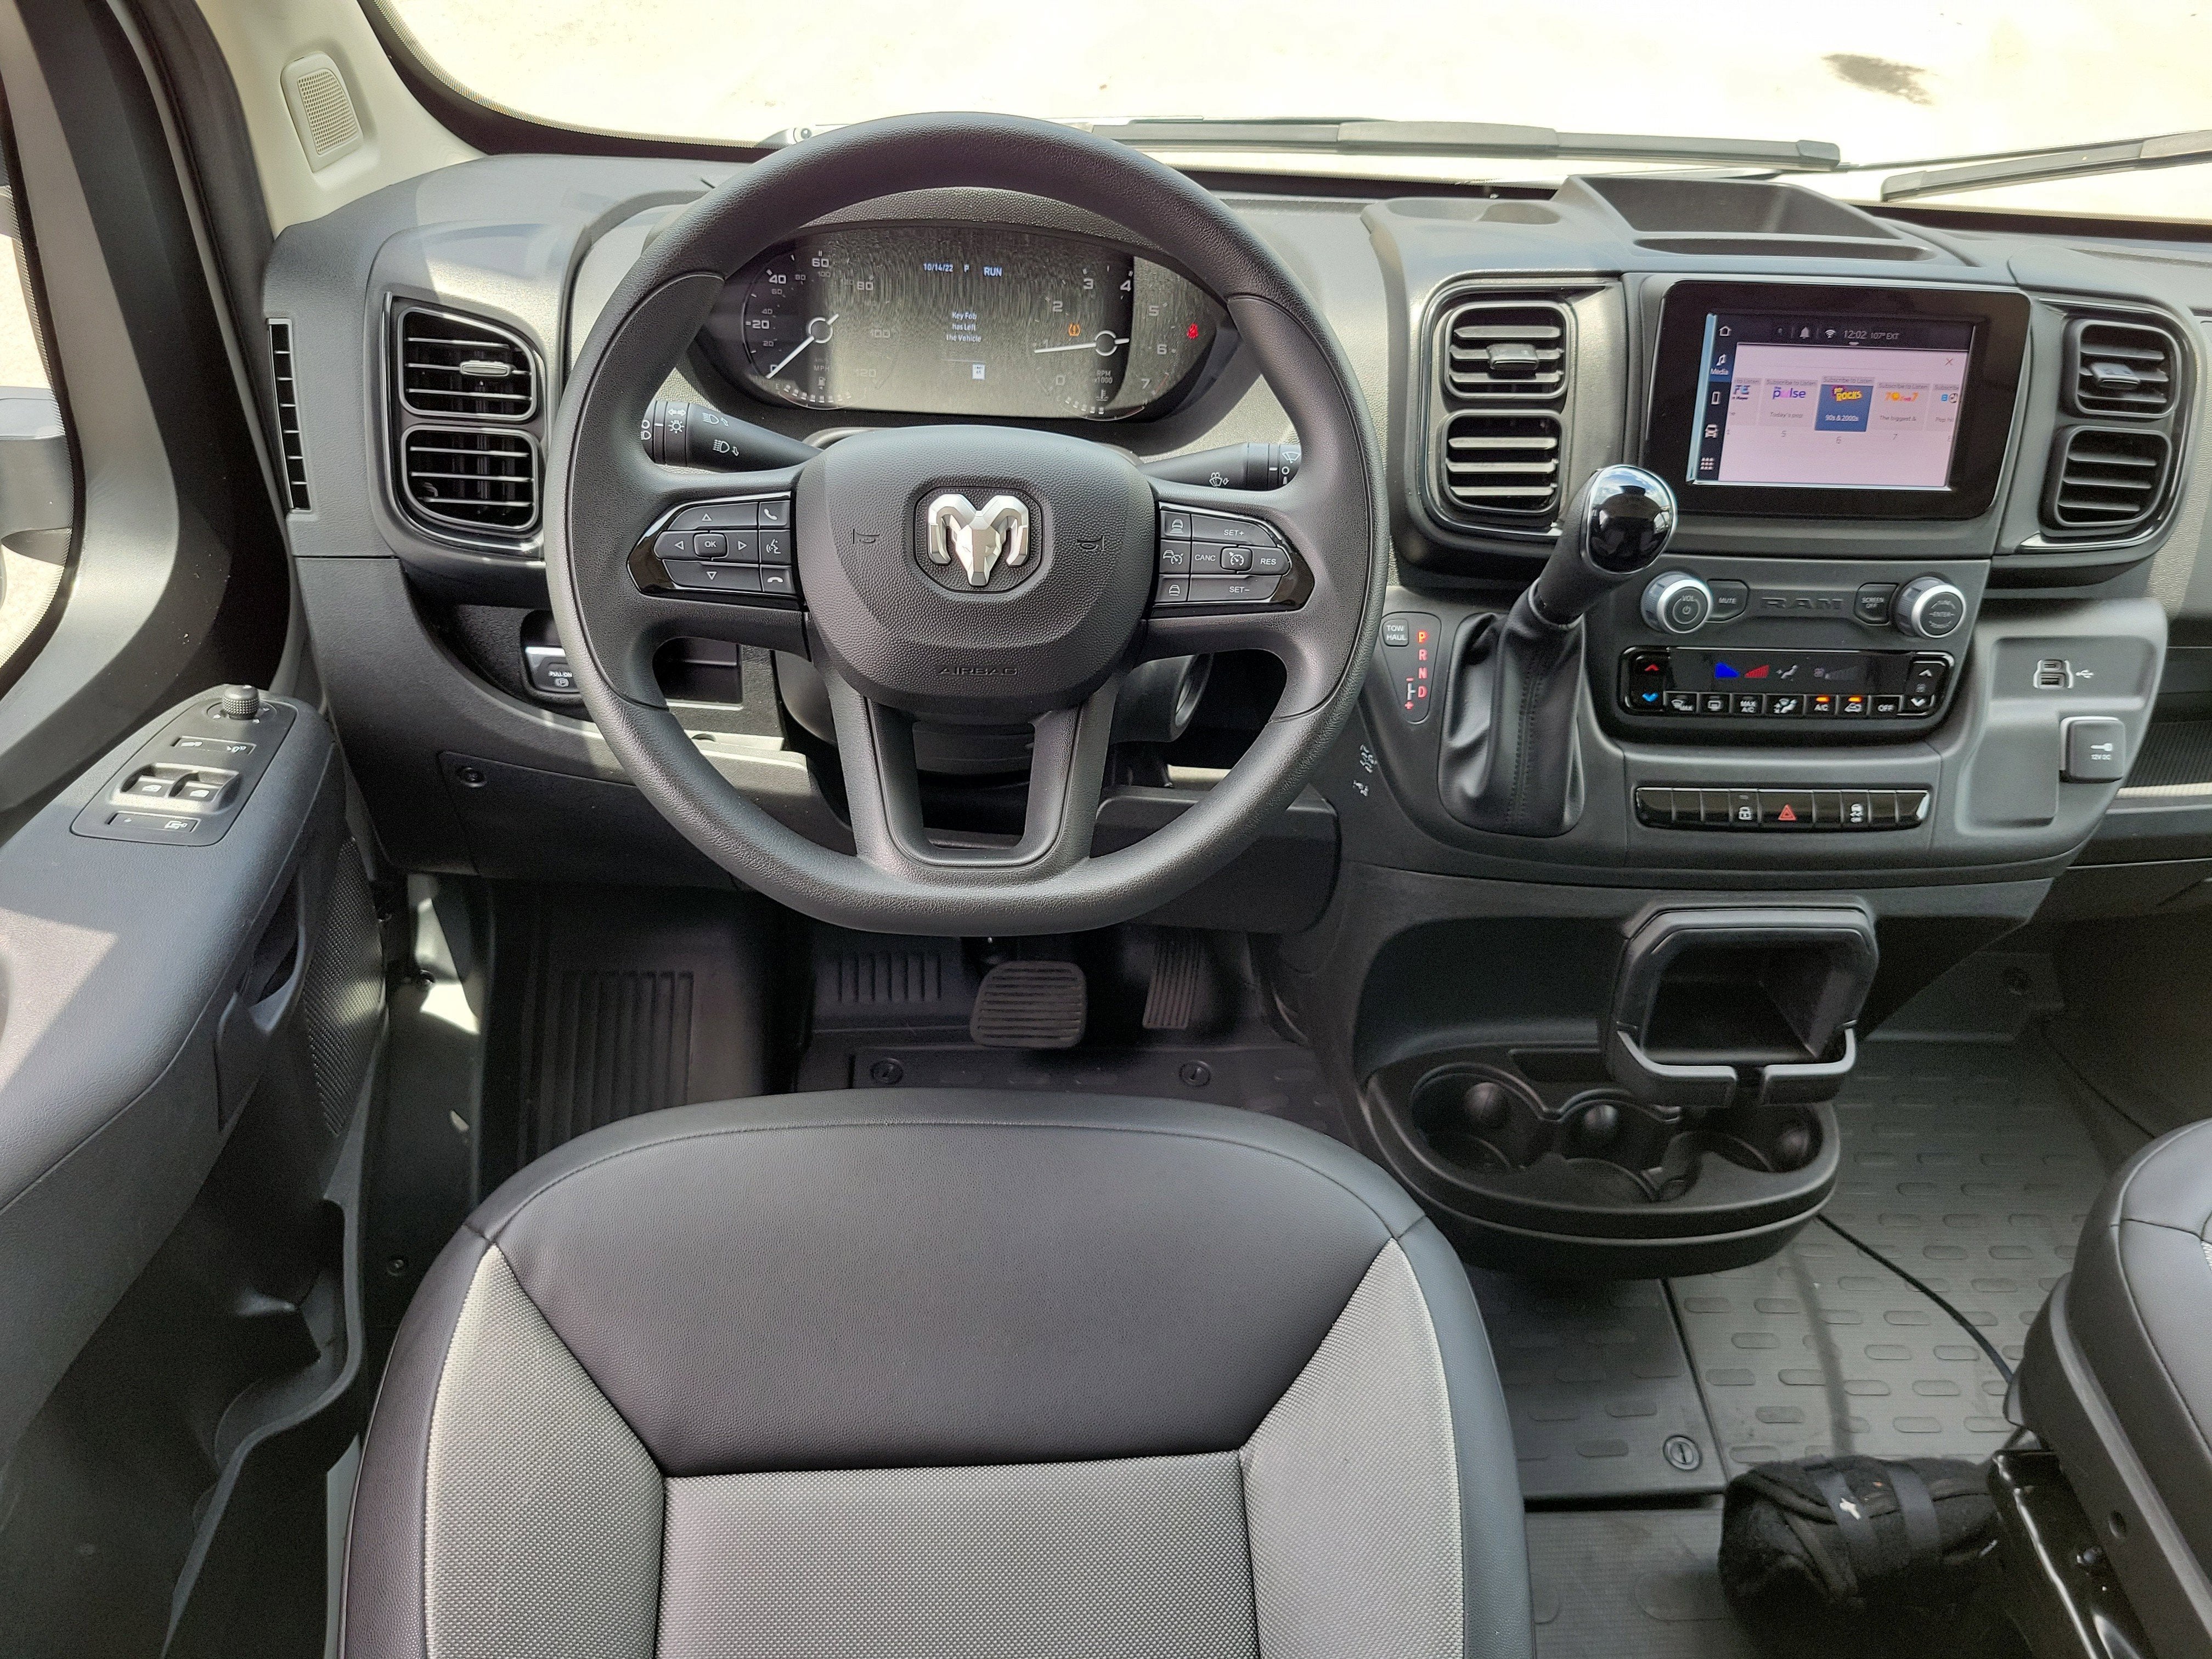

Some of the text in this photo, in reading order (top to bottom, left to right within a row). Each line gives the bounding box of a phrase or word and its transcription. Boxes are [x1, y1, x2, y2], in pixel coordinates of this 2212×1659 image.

[812, 258, 830, 268] 60
[923, 262, 954, 272] 10/14/22
[963, 263, 970, 273] P
[983, 266, 1003, 276] RUN
[769, 274, 787, 284] 40
[1083, 278, 1094, 290] 3
[856, 281, 874, 291] 80
[1120, 280, 1131, 292] 4
[1052, 301, 1063, 313] 2
[1148, 305, 1160, 317] 5
[952, 311, 964, 321] Key
[752, 320, 770, 329] 20
[964, 323, 977, 331] Left
[957, 334, 982, 343] Vehicle
[1844, 330, 1867, 339] 12:02
[1156, 343, 1168, 356] 6
[1056, 375, 1066, 386] 0
[1141, 379, 1152, 389] 7
[1761, 597, 1843, 610] RAM
[1418, 631, 1427, 644] P
[1418, 649, 1427, 661] R
[938, 667, 1018, 675] AIRBAG
[1418, 667, 1427, 679] N
[1418, 686, 1427, 698] D
[1877, 704, 1895, 712] OFF
